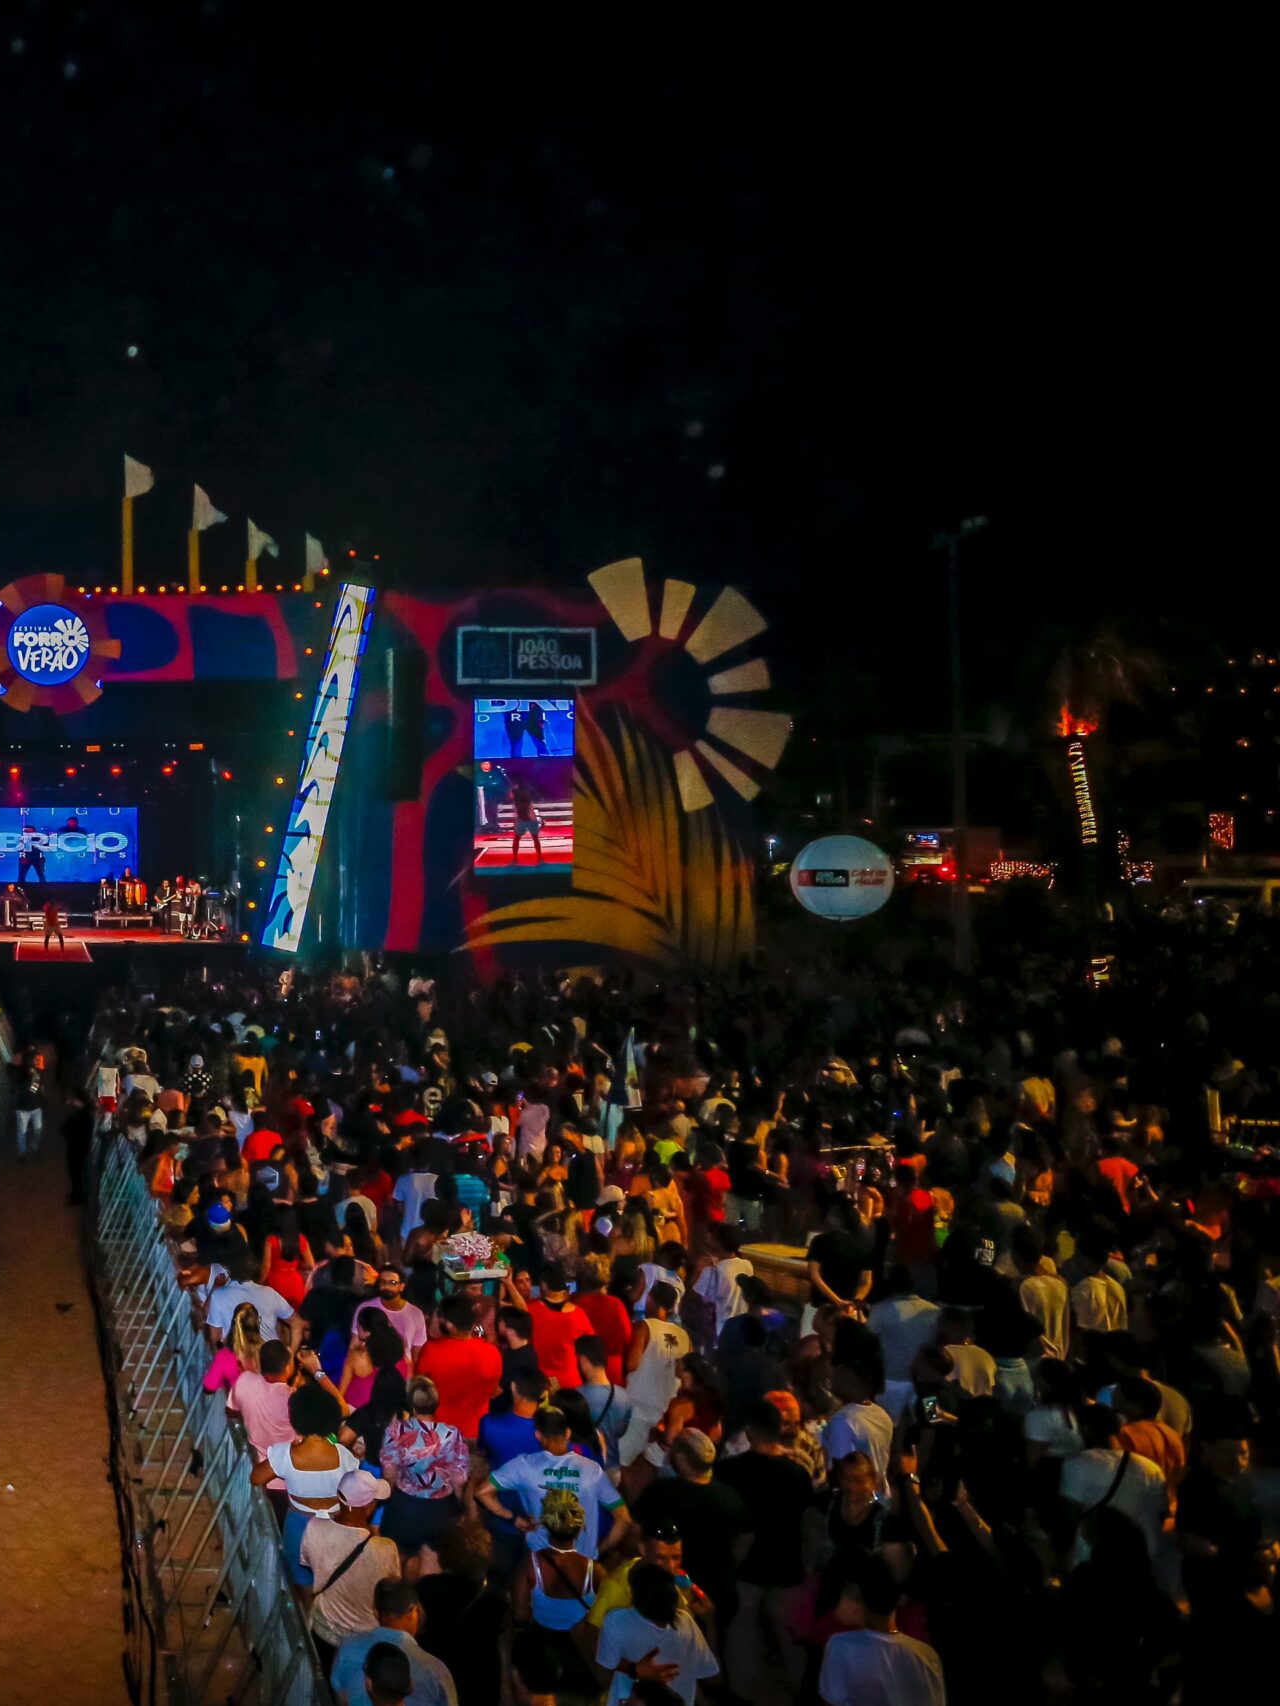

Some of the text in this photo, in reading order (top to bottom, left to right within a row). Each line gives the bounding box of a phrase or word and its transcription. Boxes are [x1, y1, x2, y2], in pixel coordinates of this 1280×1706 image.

[517, 635, 558, 655] JOÃO
[17, 645, 79, 673] VERÃO
[517, 655, 583, 670] PESSOA
[543, 1466, 580, 1480] crefisa
